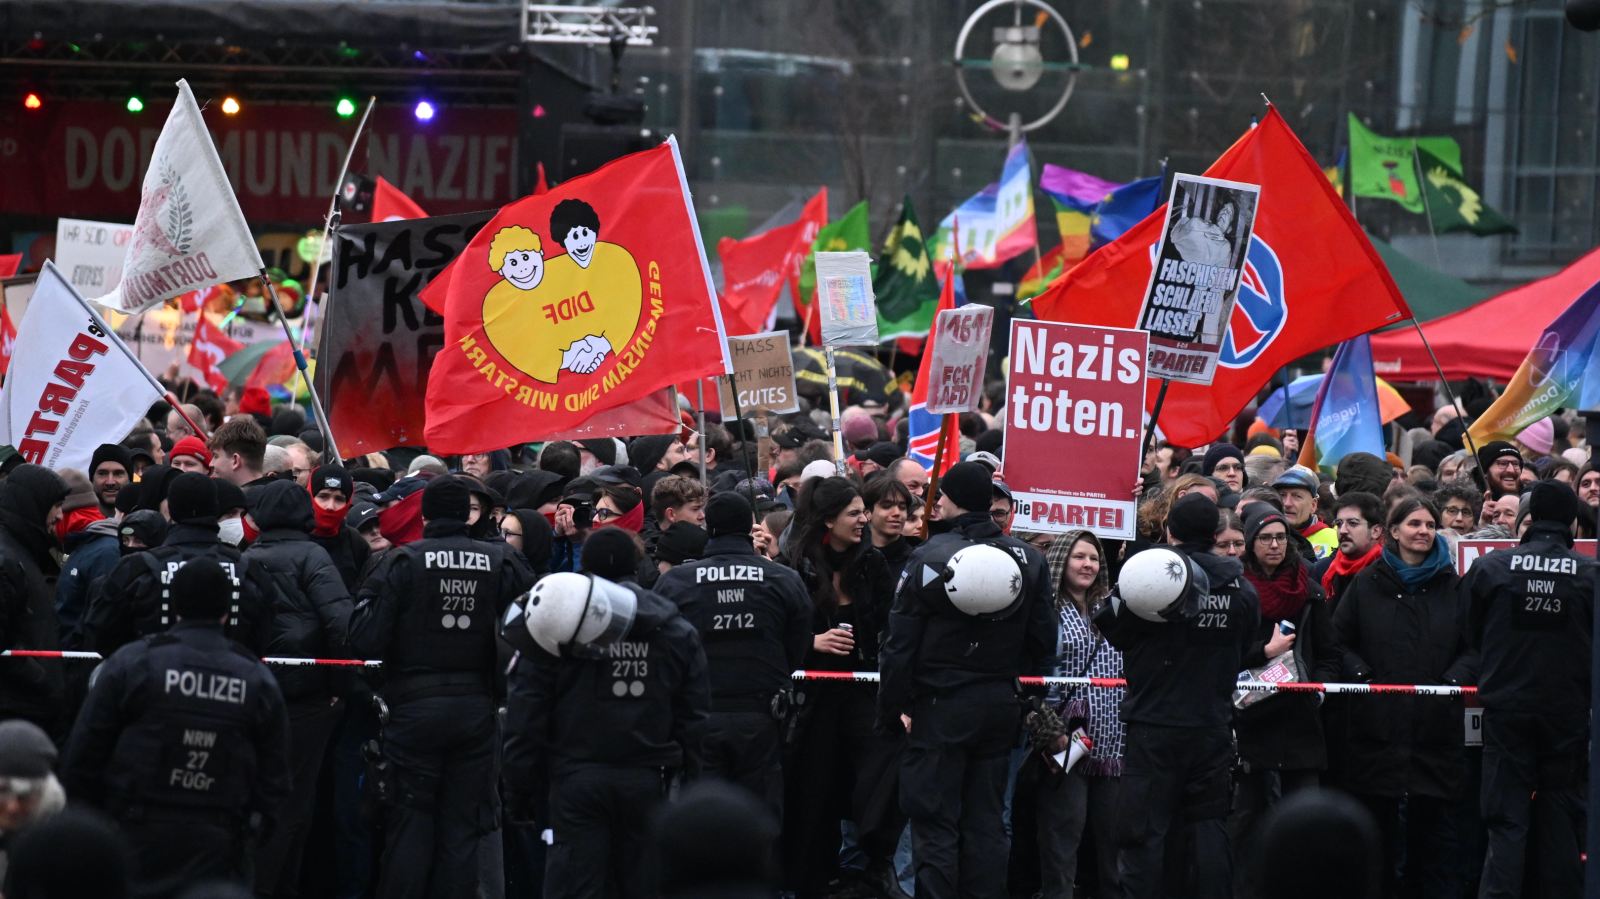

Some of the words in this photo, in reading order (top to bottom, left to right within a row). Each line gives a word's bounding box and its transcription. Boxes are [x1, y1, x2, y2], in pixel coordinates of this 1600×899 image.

[65, 126, 350, 198] DOMUND
[368, 133, 518, 201] NAZIF
[1159, 258, 1238, 291] FASCHISTEN
[1152, 283, 1220, 314] SCHLAFEN
[1145, 307, 1202, 337] LASSEN
[735, 338, 775, 356] HASS
[1014, 325, 1141, 385] Nazis
[759, 365, 792, 379] NICHTS
[1151, 350, 1209, 375] PARTEI
[942, 364, 973, 386] FCK
[738, 386, 787, 408] GUTES
[941, 385, 969, 405] AFD
[1012, 382, 1136, 439] töten.
[1086, 491, 1107, 499] PARTEI
[1031, 501, 1124, 530] PARTEI
[425, 550, 491, 571] POLIZEI
[1510, 555, 1577, 575] POLIZEI
[696, 564, 764, 583] POLIZEI
[440, 578, 478, 594] NRW
[717, 588, 745, 603] NRW
[1527, 579, 1555, 594] NRW
[442, 596, 475, 611] 2713
[1198, 595, 1231, 610] NRW
[1525, 596, 1561, 613] 2743
[713, 613, 755, 630] 2712
[1198, 613, 1228, 628] 2712
[609, 642, 649, 658] NRW
[612, 661, 648, 677] 2713
[164, 669, 247, 705] POLIZEI
[182, 728, 217, 748] NRW
[186, 751, 209, 769] 27
